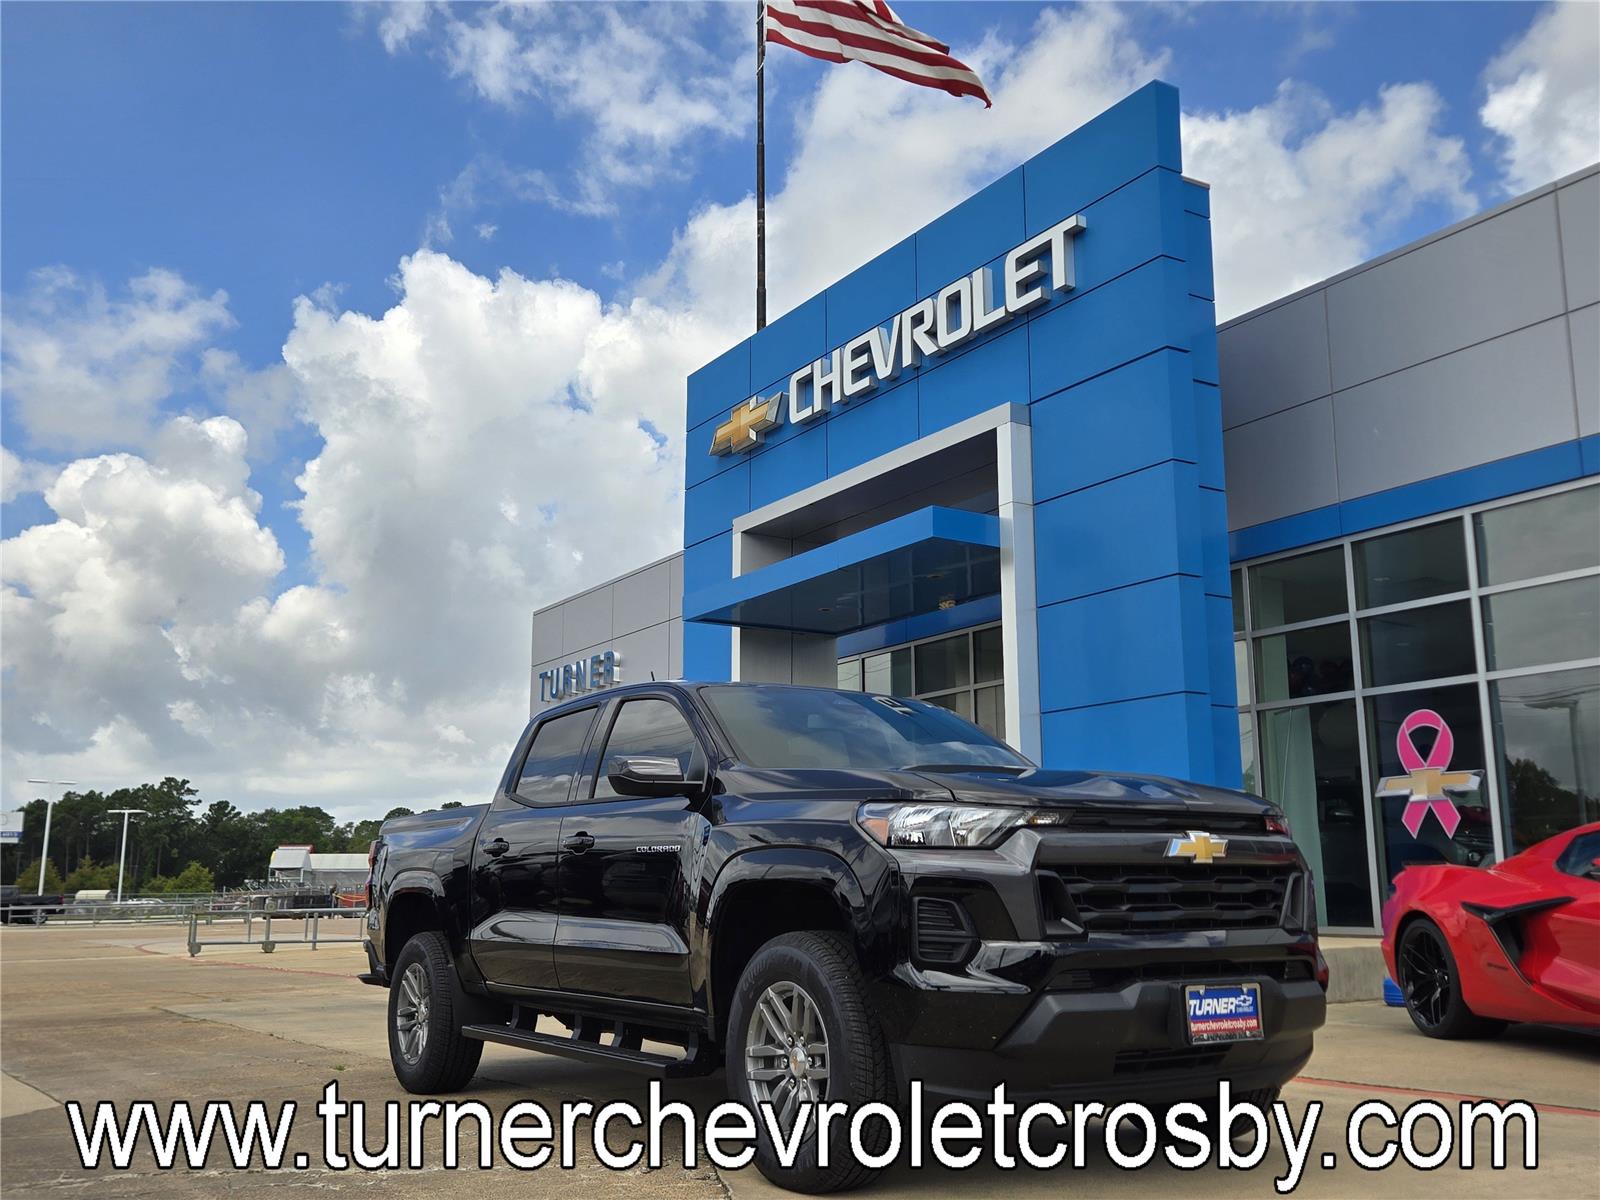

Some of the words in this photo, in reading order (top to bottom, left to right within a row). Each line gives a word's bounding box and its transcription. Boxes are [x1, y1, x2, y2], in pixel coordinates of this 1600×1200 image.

[788, 214, 1087, 425] CHEVROLET
[539, 650, 620, 703] TURNER
[636, 845, 681, 853] COLORADO
[1188, 997, 1236, 1016] TURNER
